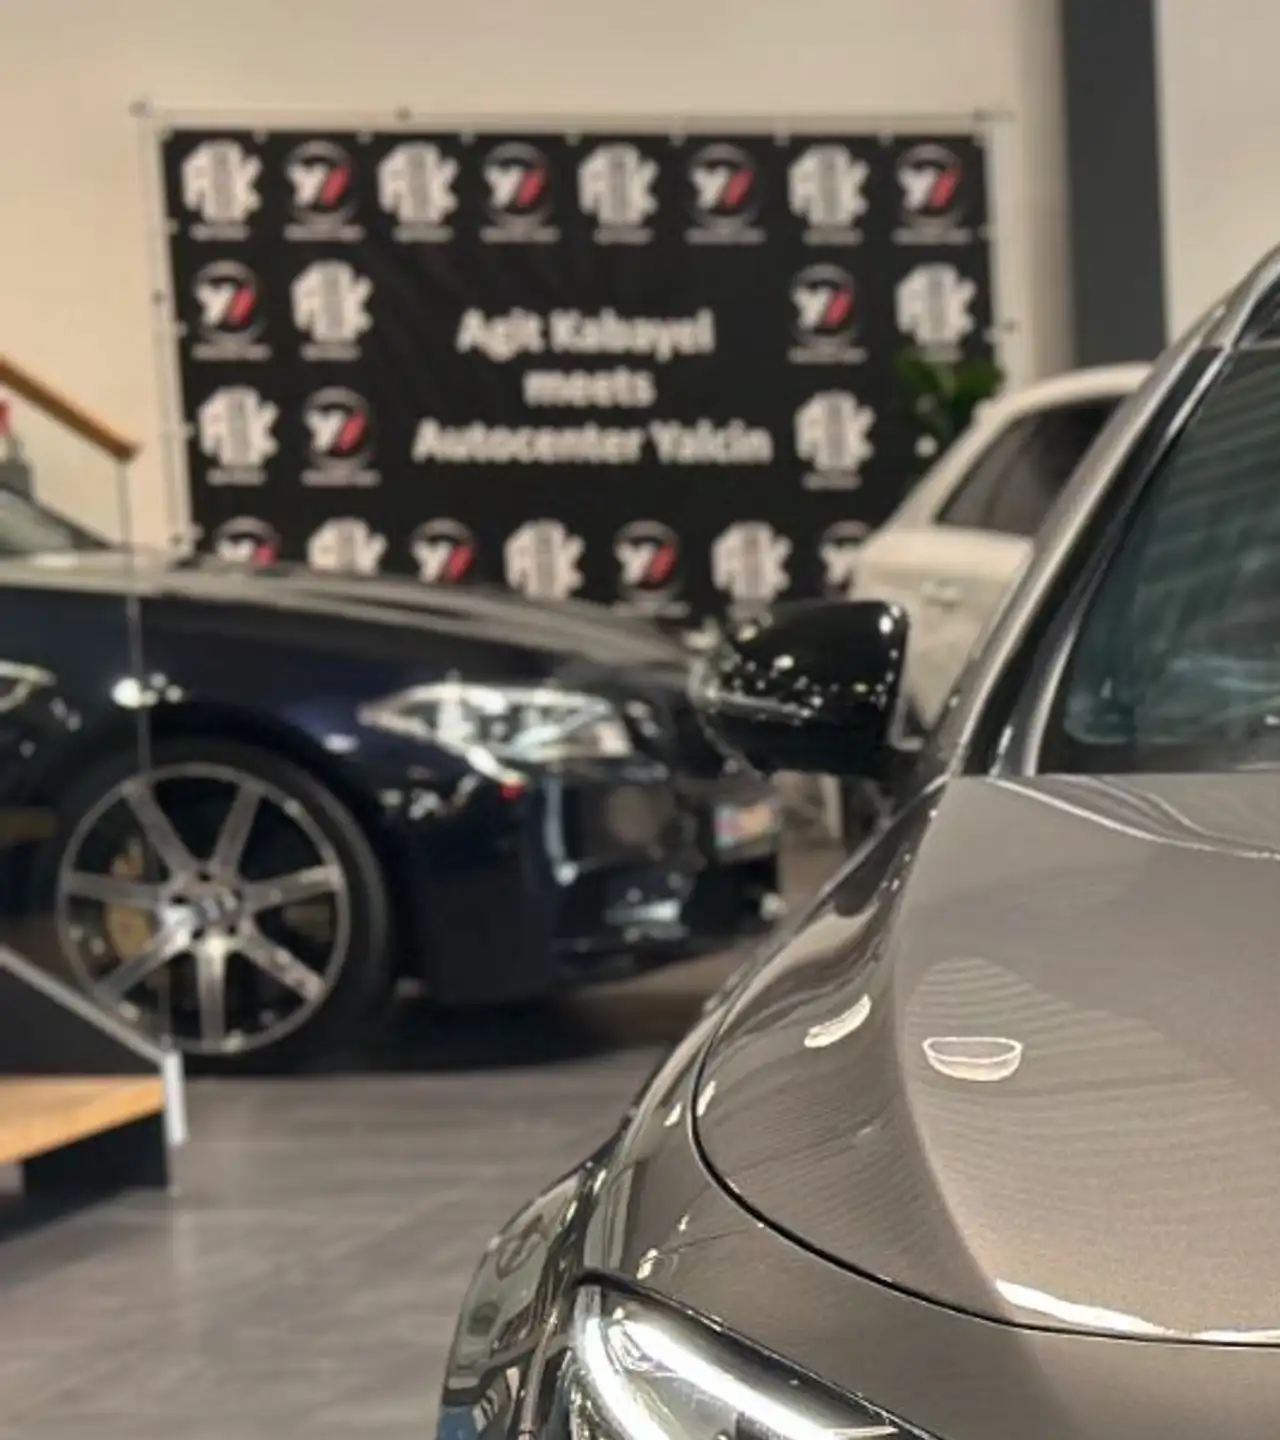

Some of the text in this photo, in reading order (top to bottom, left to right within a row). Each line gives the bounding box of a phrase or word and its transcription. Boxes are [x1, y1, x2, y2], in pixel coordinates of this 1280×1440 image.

[456, 308, 546, 362] Agit
[522, 366, 656, 408] meets
[411, 416, 646, 464] Autocenter
